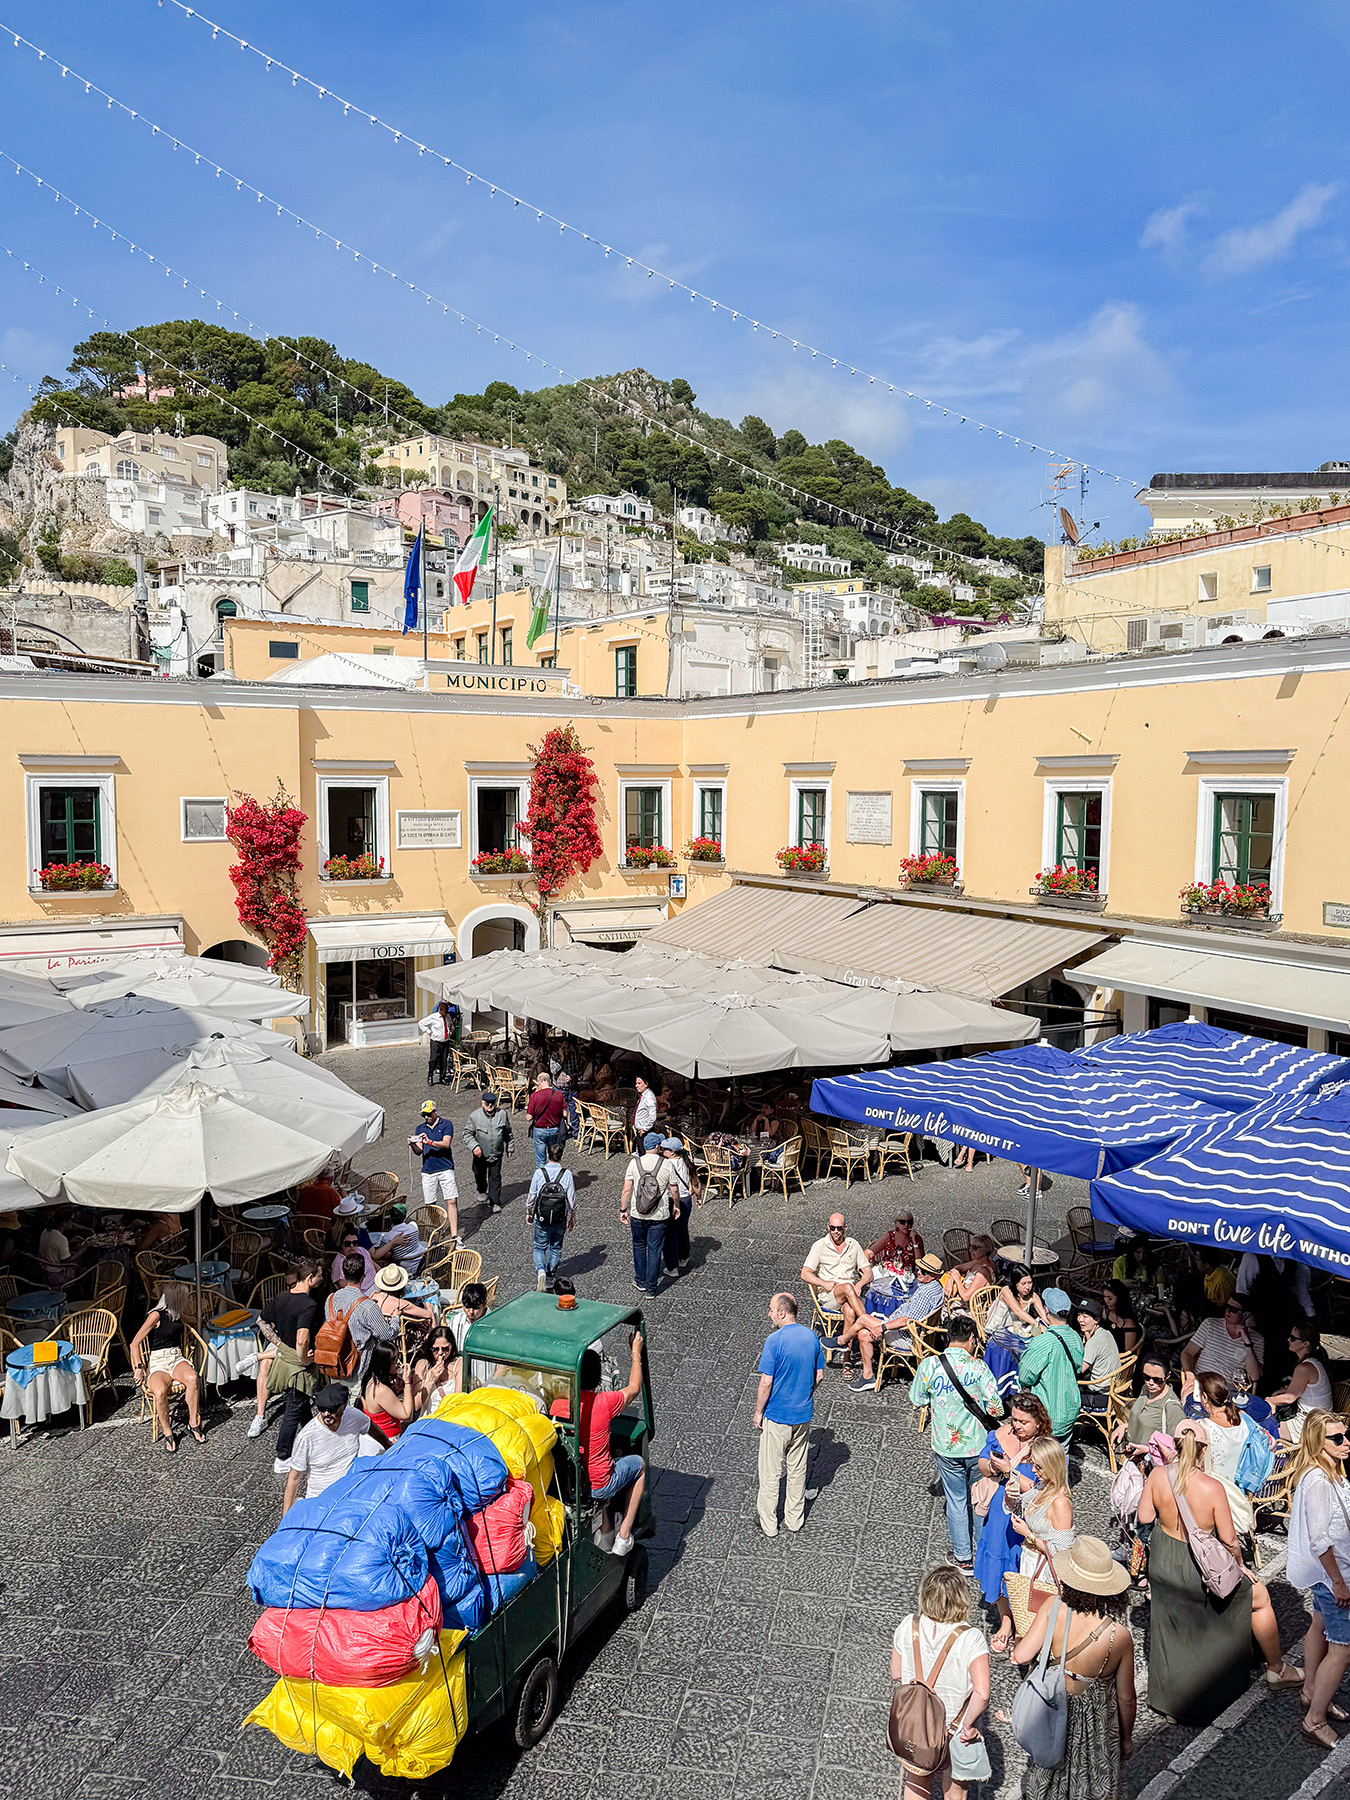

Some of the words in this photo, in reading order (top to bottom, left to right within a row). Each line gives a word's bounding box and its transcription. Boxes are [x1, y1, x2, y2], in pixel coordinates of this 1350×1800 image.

[446, 674, 547, 692] MUNICIPIO
[371, 945, 405, 958] TOD'S
[47, 958, 61, 969] La
[844, 969, 868, 986] Gran
[865, 1106, 895, 1121] DON'T
[894, 1106, 923, 1129] live
[923, 1111, 951, 1136] life
[951, 1123, 1001, 1147] WITHOUT
[1168, 1218, 1210, 1236] DON'T
[1213, 1217, 1257, 1245] live
[1257, 1222, 1297, 1254] life
[1298, 1239, 1350, 1266] WITHO
